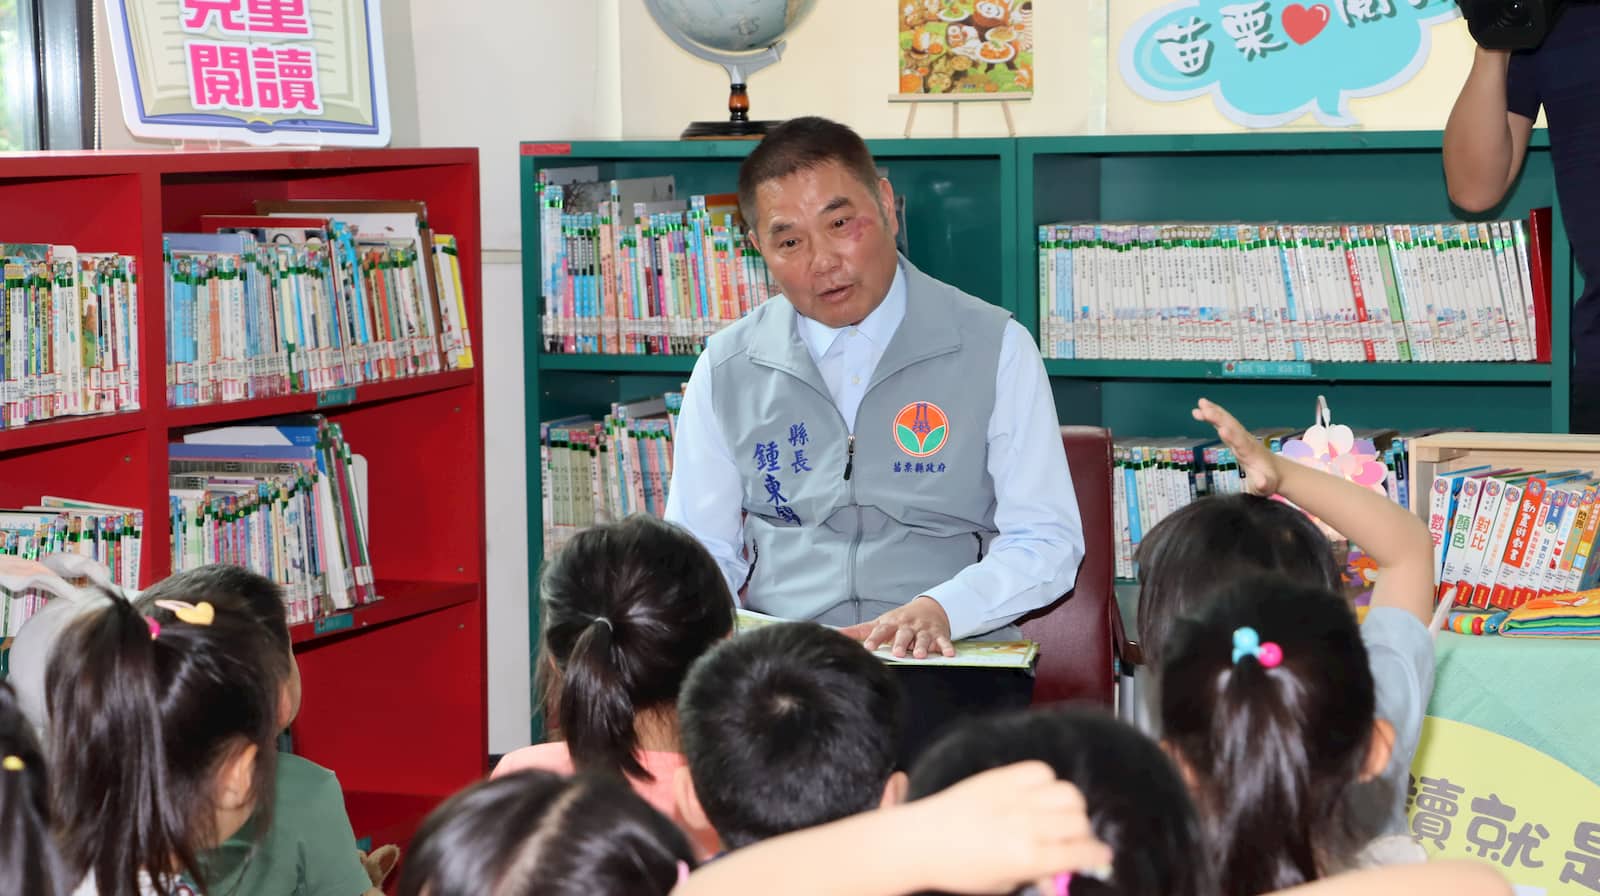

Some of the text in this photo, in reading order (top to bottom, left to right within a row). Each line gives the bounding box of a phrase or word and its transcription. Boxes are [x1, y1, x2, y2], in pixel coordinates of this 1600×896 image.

[1155, 2, 1287, 76] 苗栗
[189, 44, 319, 110] 閱讀
[788, 422, 812, 474] 縣長
[893, 462, 947, 473] 苗栗縣政府
[1453, 514, 1471, 549] 顏色
[1471, 516, 1490, 551] 對比
